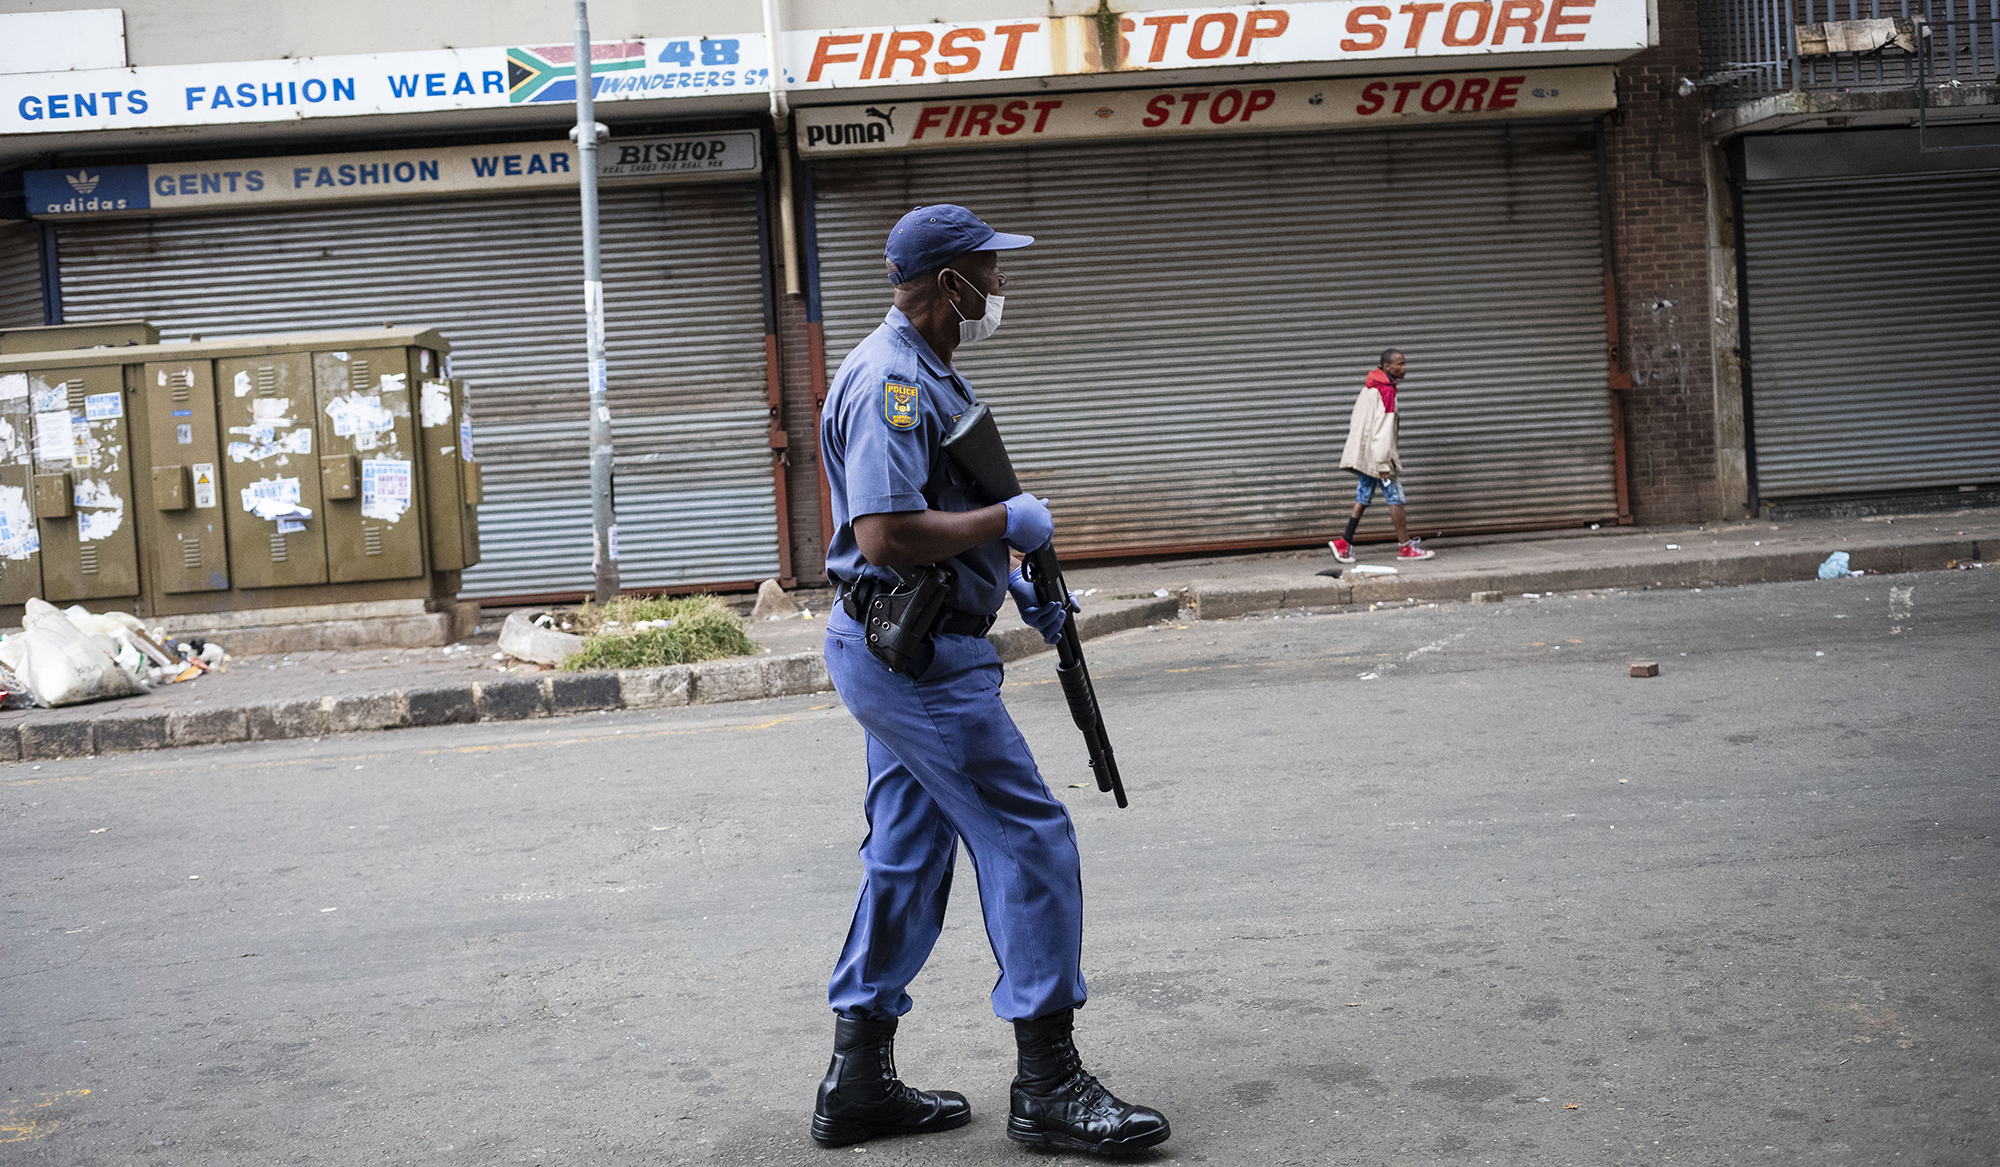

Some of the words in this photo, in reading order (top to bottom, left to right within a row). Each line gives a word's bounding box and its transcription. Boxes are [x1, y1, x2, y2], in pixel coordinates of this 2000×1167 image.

[658, 39, 739, 67] 48
[806, 23, 1040, 82] FIRST
[1340, 0, 1597, 52] STORE
[601, 70, 736, 93] WANDERERS
[18, 89, 148, 121] GENTS
[185, 78, 356, 111] FASHION
[388, 70, 504, 98] WEAR
[912, 101, 1063, 139] FIRST
[1142, 89, 1276, 128] STOP
[1356, 76, 1526, 116] STORE
[807, 122, 885, 146] PUMA
[618, 141, 725, 165] BISHOP
[154, 170, 264, 196] GENTS
[293, 160, 440, 189] FASHION
[471, 152, 571, 178] WEAR
[661, 162, 681, 170] FOR
[47, 197, 127, 213] adidas
[888, 385, 916, 396] POLICE
